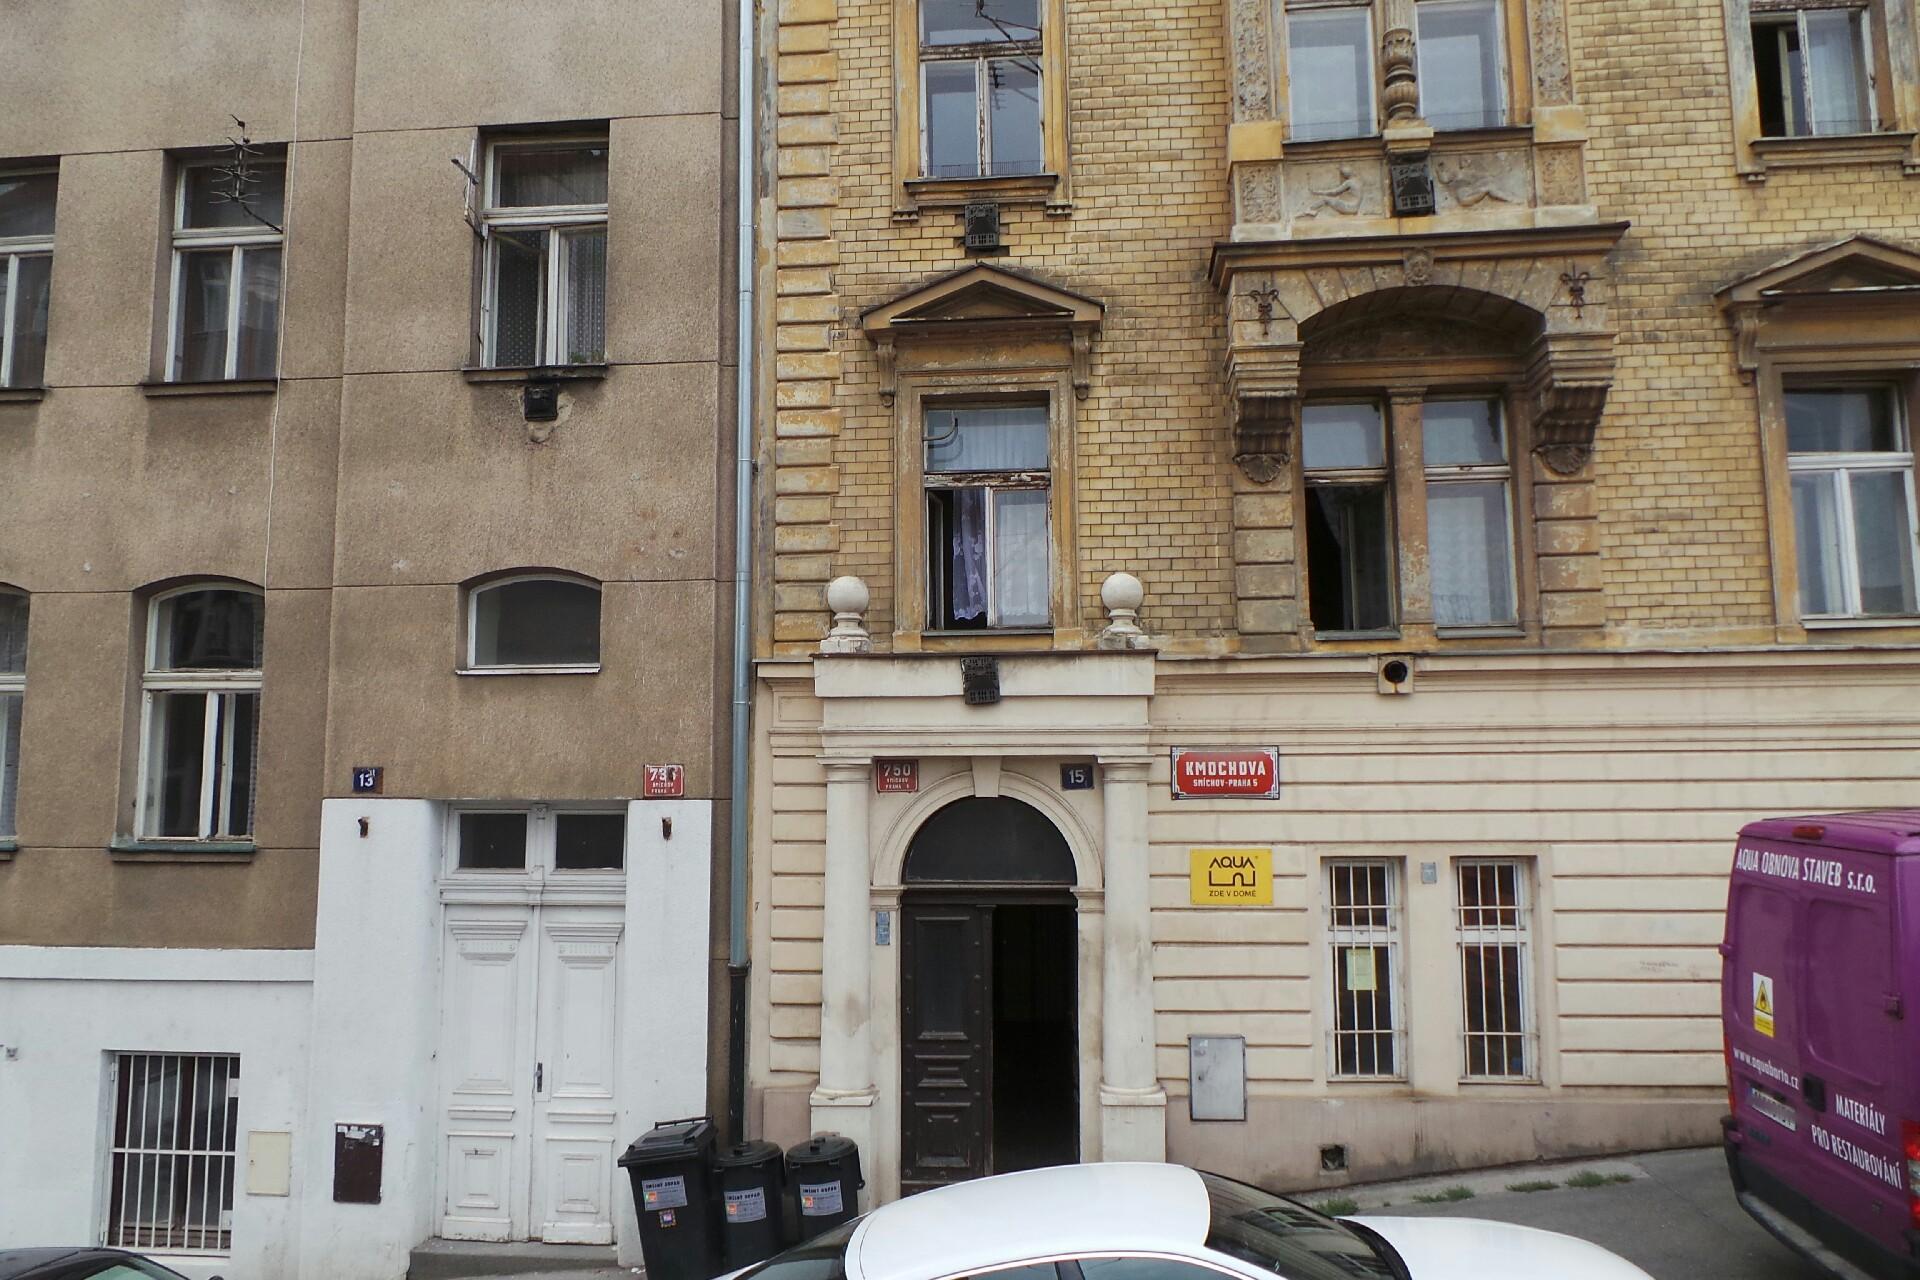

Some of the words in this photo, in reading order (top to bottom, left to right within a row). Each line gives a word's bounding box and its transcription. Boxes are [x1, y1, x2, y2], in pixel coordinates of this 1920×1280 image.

[883, 764, 911, 777] 750
[1185, 761, 1266, 776] KMOCHOVA
[1069, 769, 1085, 784] 15
[1252, 778, 1258, 787] 5
[1209, 856, 1255, 869] AQUA
[1736, 848, 1760, 872] AQUA
[1761, 851, 1800, 880] OBNOVA
[1802, 857, 1843, 887] STAVEB
[1847, 871, 1877, 893] s.r.o.
[1836, 1093, 1886, 1136] MATERIÁLY
[1811, 1124, 1830, 1151] PRO
[1831, 1134, 1903, 1190] RESTAUROVÁNÍ
